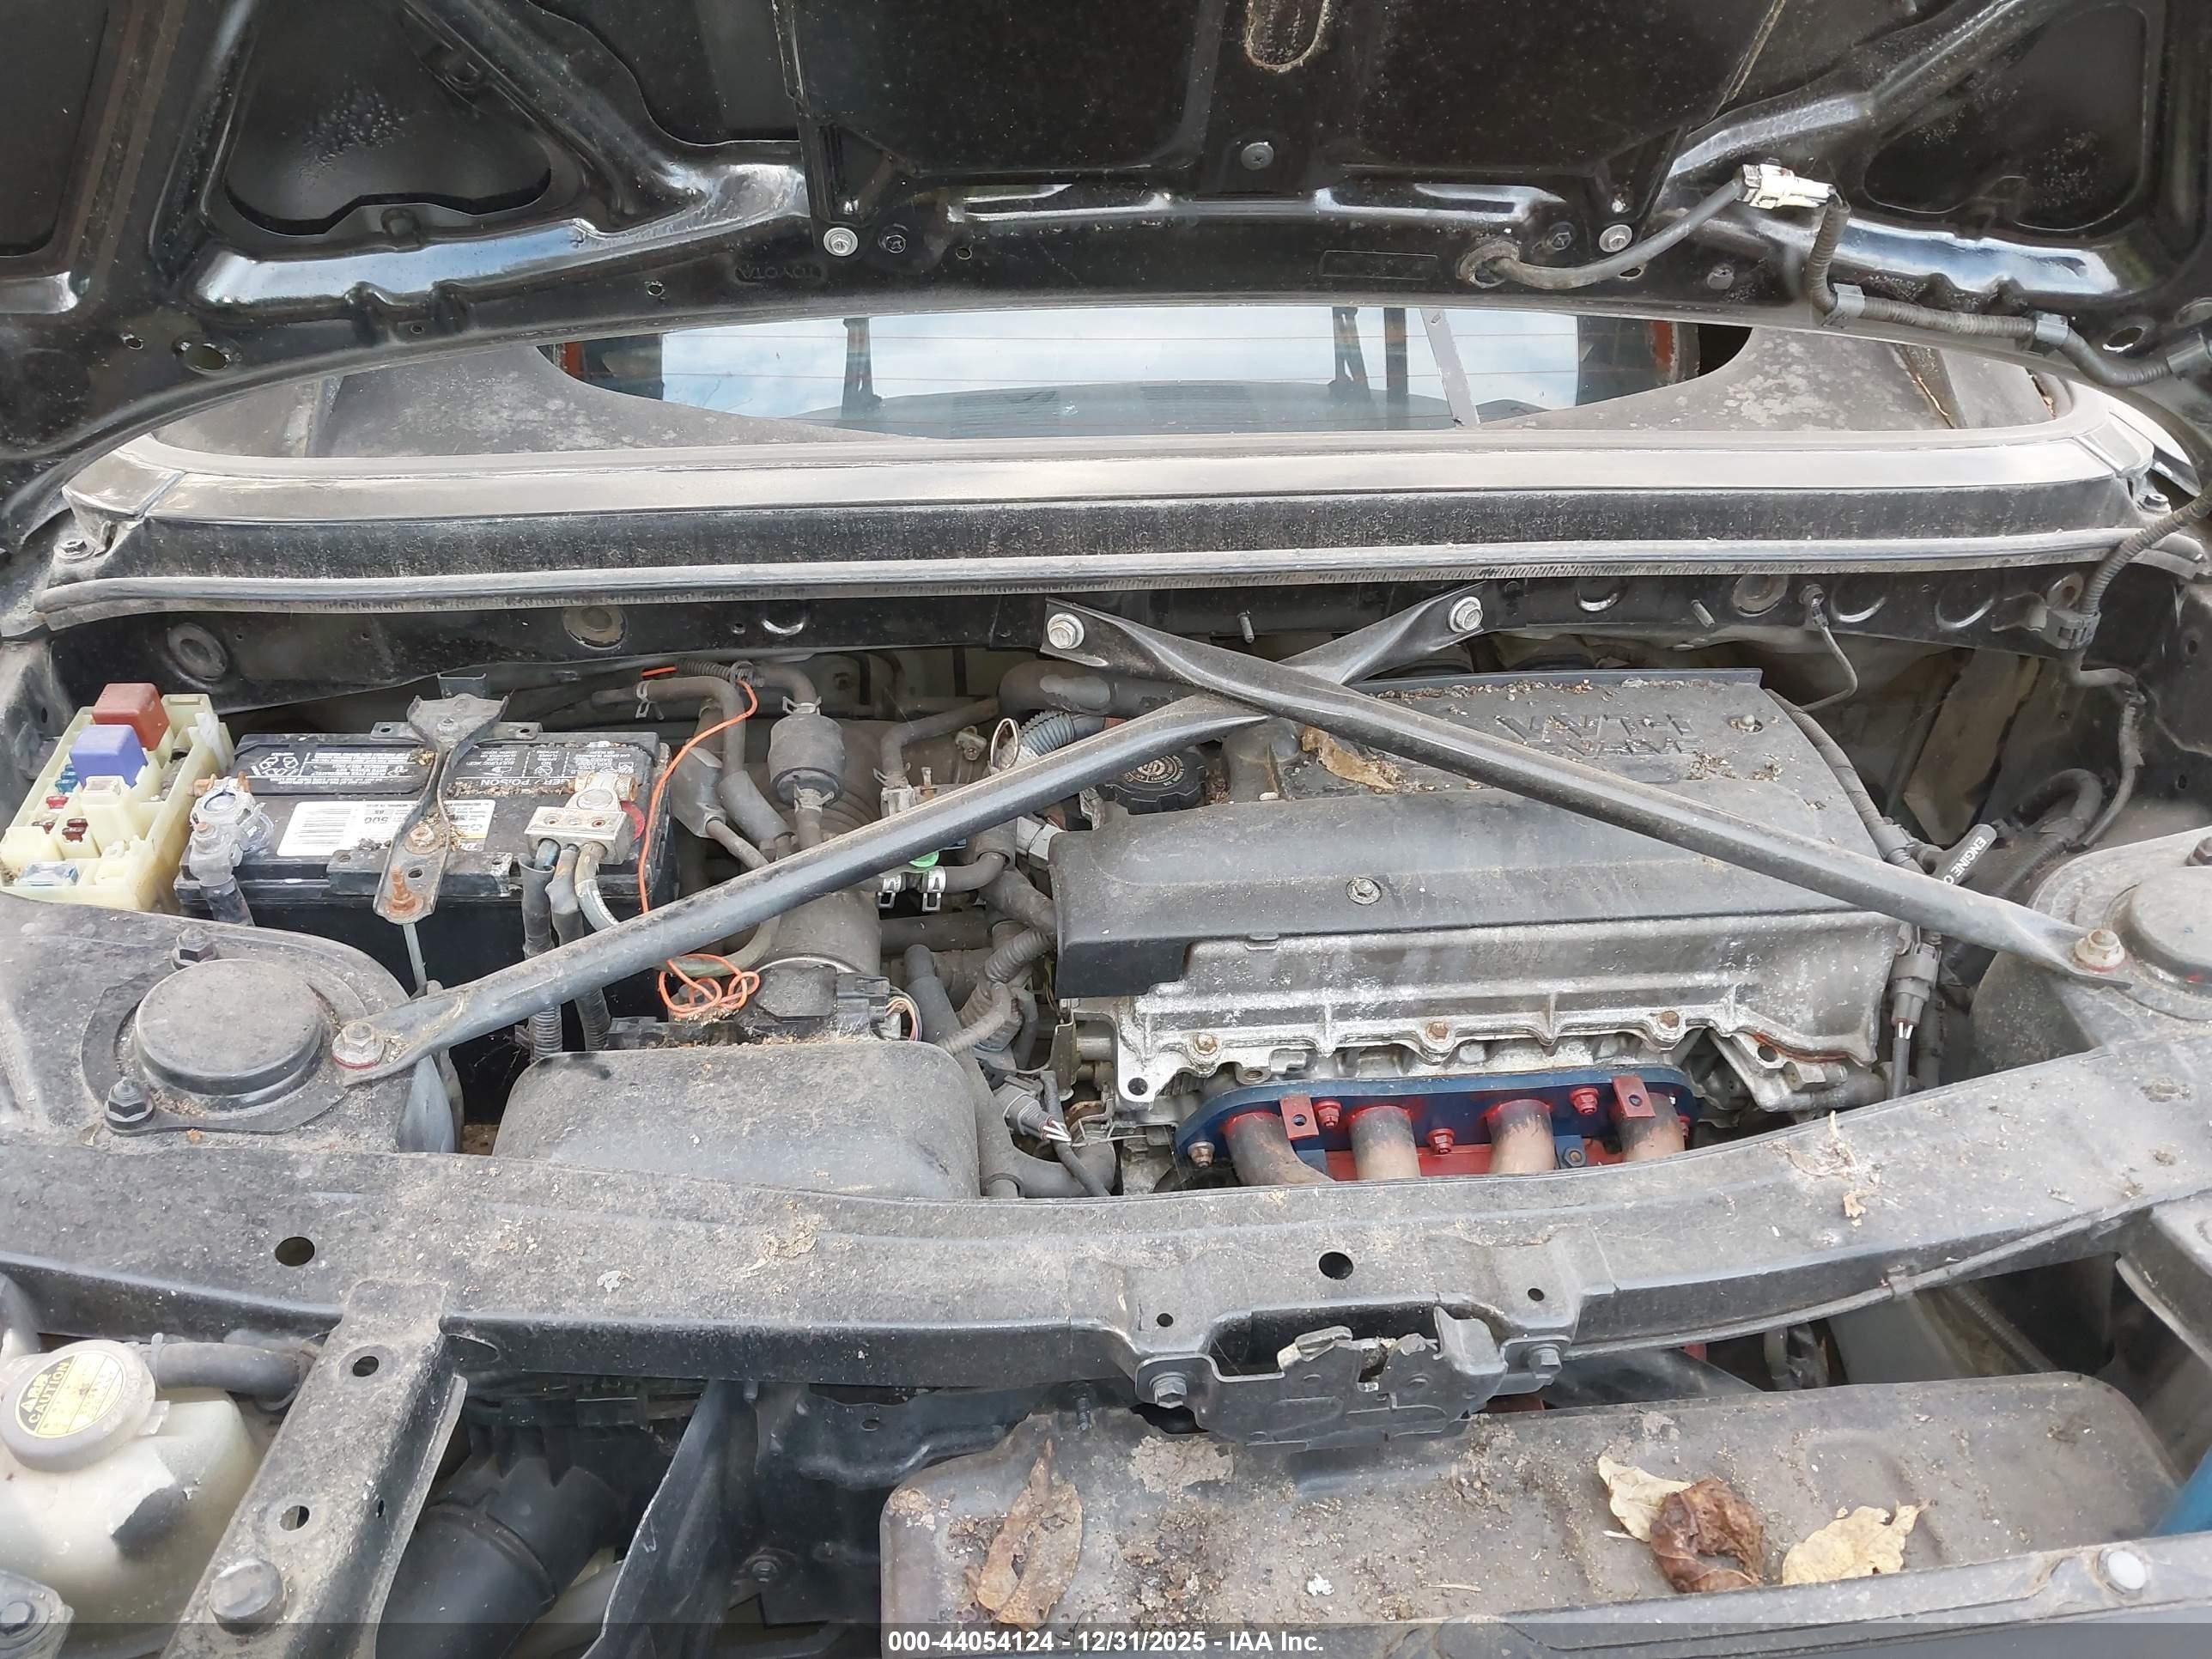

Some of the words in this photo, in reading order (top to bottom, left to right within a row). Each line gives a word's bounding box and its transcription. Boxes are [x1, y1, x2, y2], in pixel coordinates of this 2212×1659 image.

[1951, 836, 1987, 877] ENGINE
[1944, 875, 1955, 885] O
[28, 1360, 70, 1424] CAUTION
